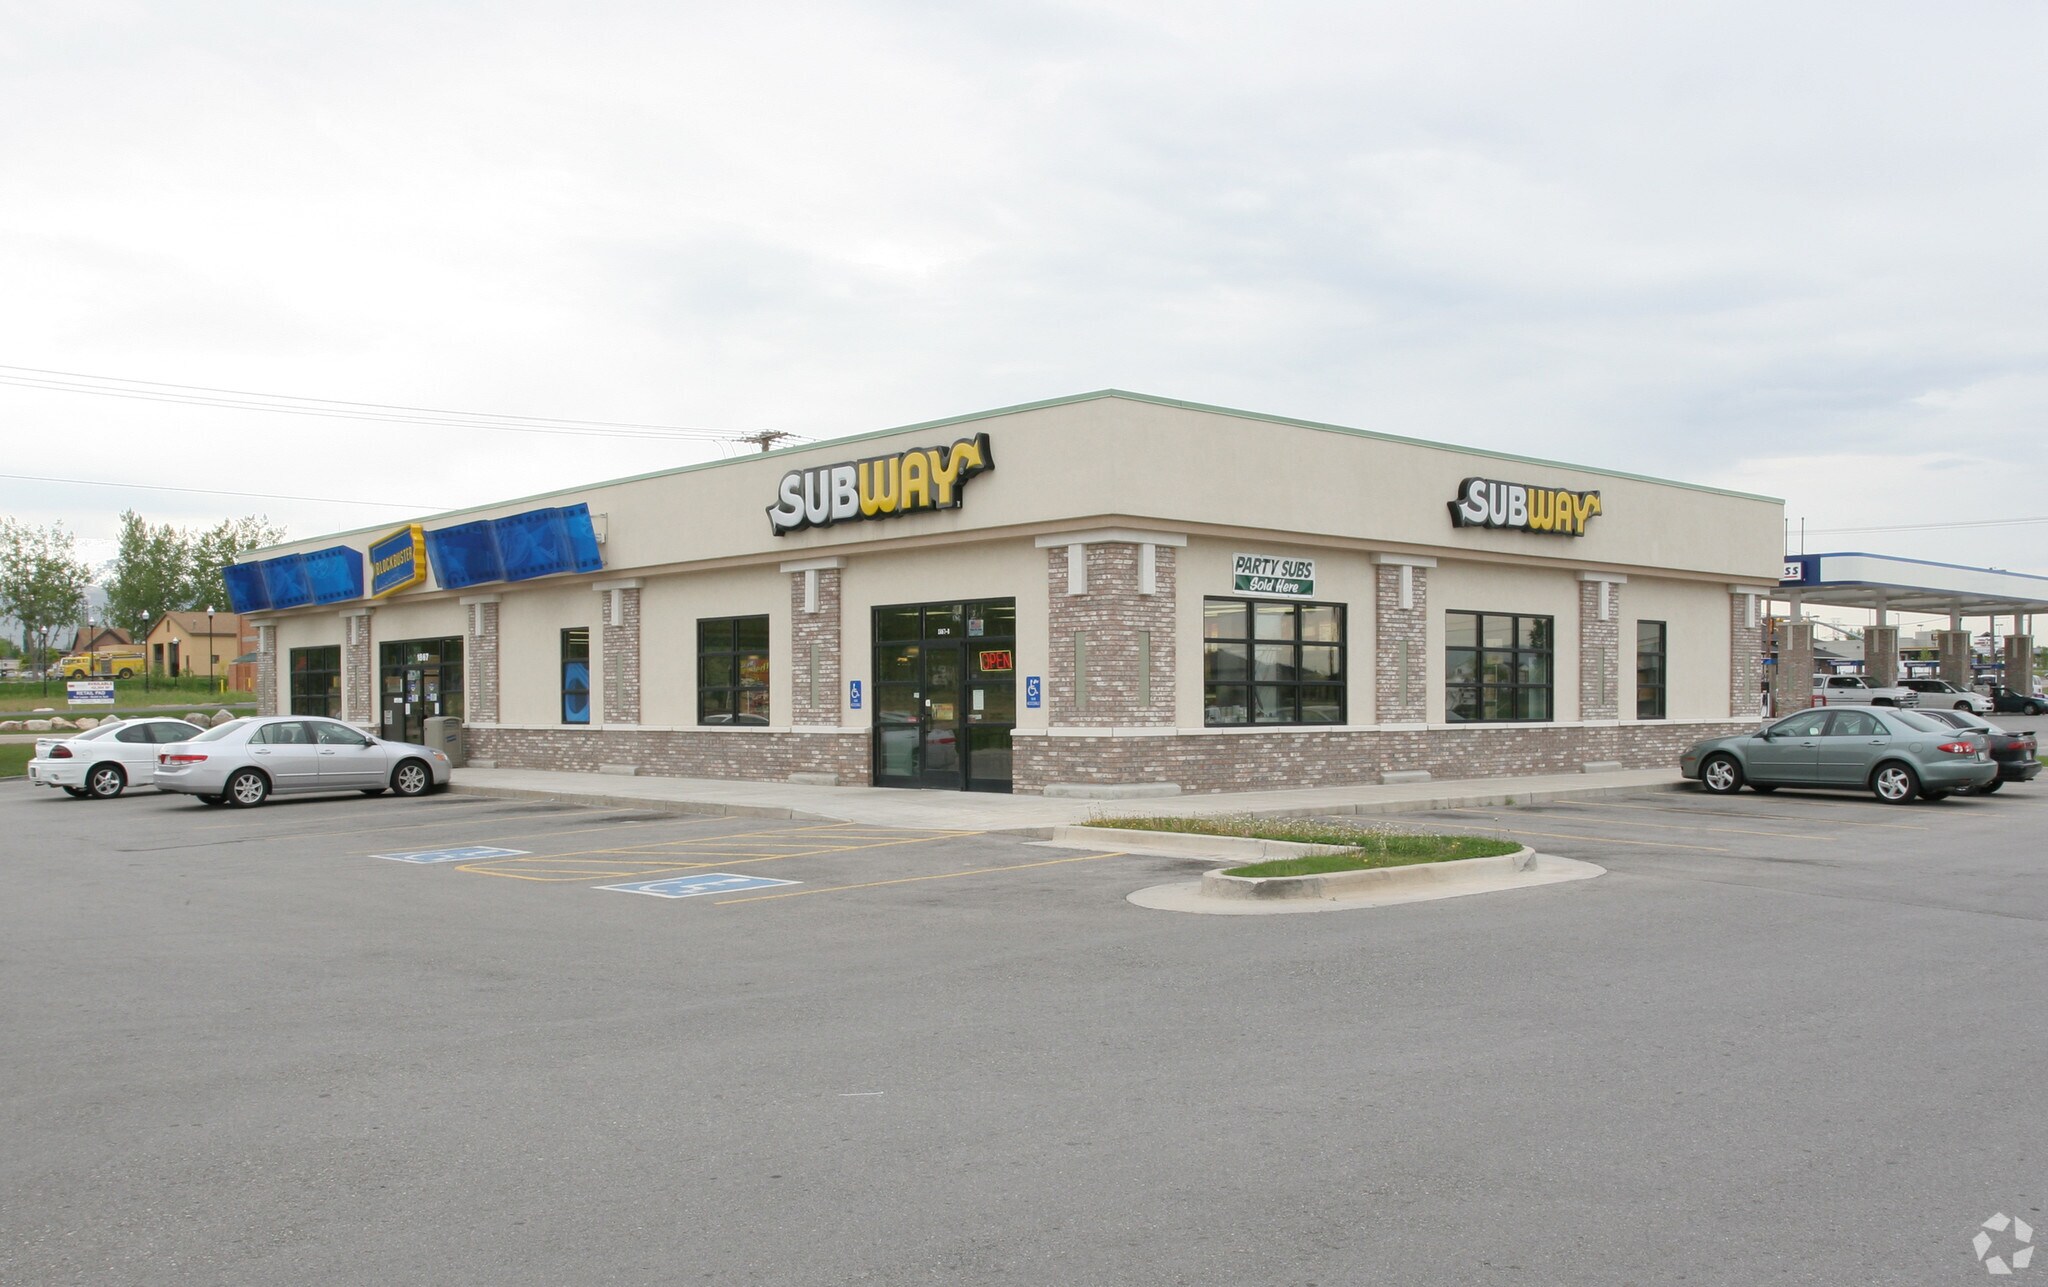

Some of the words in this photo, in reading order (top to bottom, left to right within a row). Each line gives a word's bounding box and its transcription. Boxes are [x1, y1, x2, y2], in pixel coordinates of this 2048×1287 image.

[769, 440, 983, 528] SUBWAY
[1459, 480, 1601, 533] SUBWAY
[375, 546, 413, 576] BLOCKBUSTER
[1235, 556, 1279, 575] PARTY
[1281, 560, 1312, 578] SUBS
[1249, 576, 1274, 591] Sold
[1275, 578, 1299, 593] Here
[981, 652, 1010, 670] OPEN
